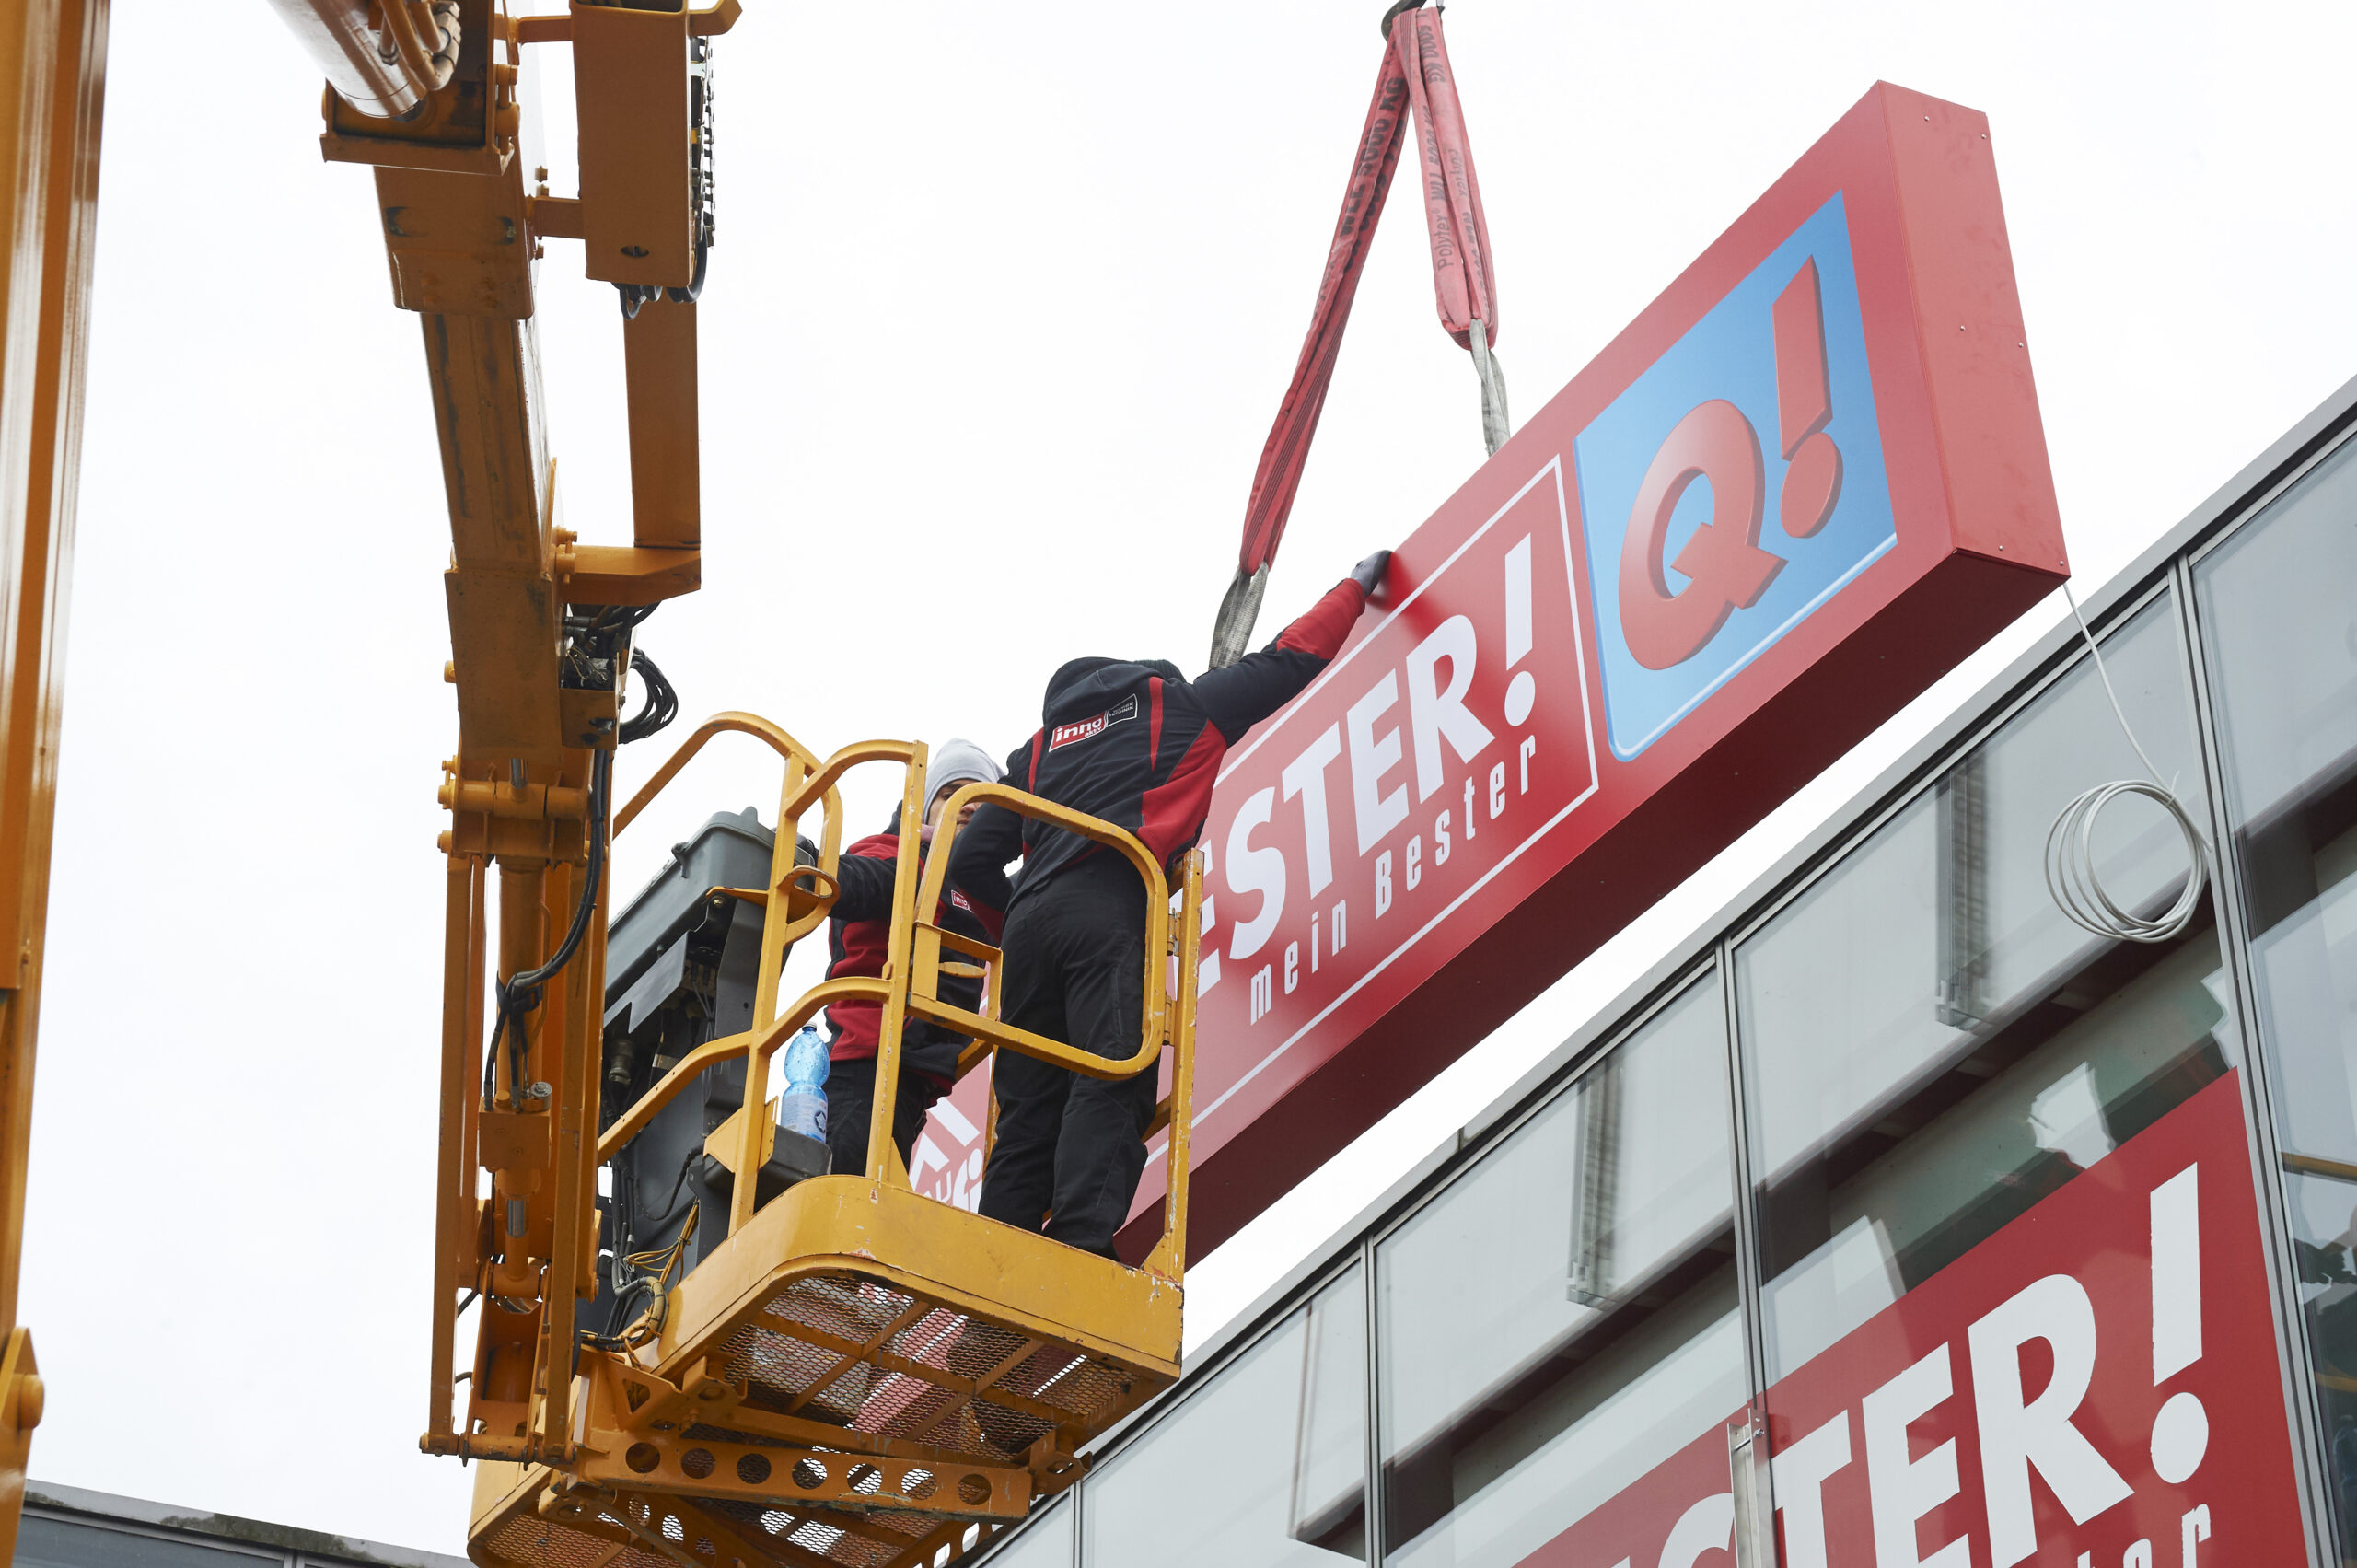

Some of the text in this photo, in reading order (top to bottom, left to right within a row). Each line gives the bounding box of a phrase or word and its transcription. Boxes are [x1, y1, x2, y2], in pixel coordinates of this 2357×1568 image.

[1379, 77, 1406, 111] KG
[1618, 254, 1843, 670] Q!
[1056, 717, 1103, 743] inno
[1250, 734, 1536, 1026] mein Bester
